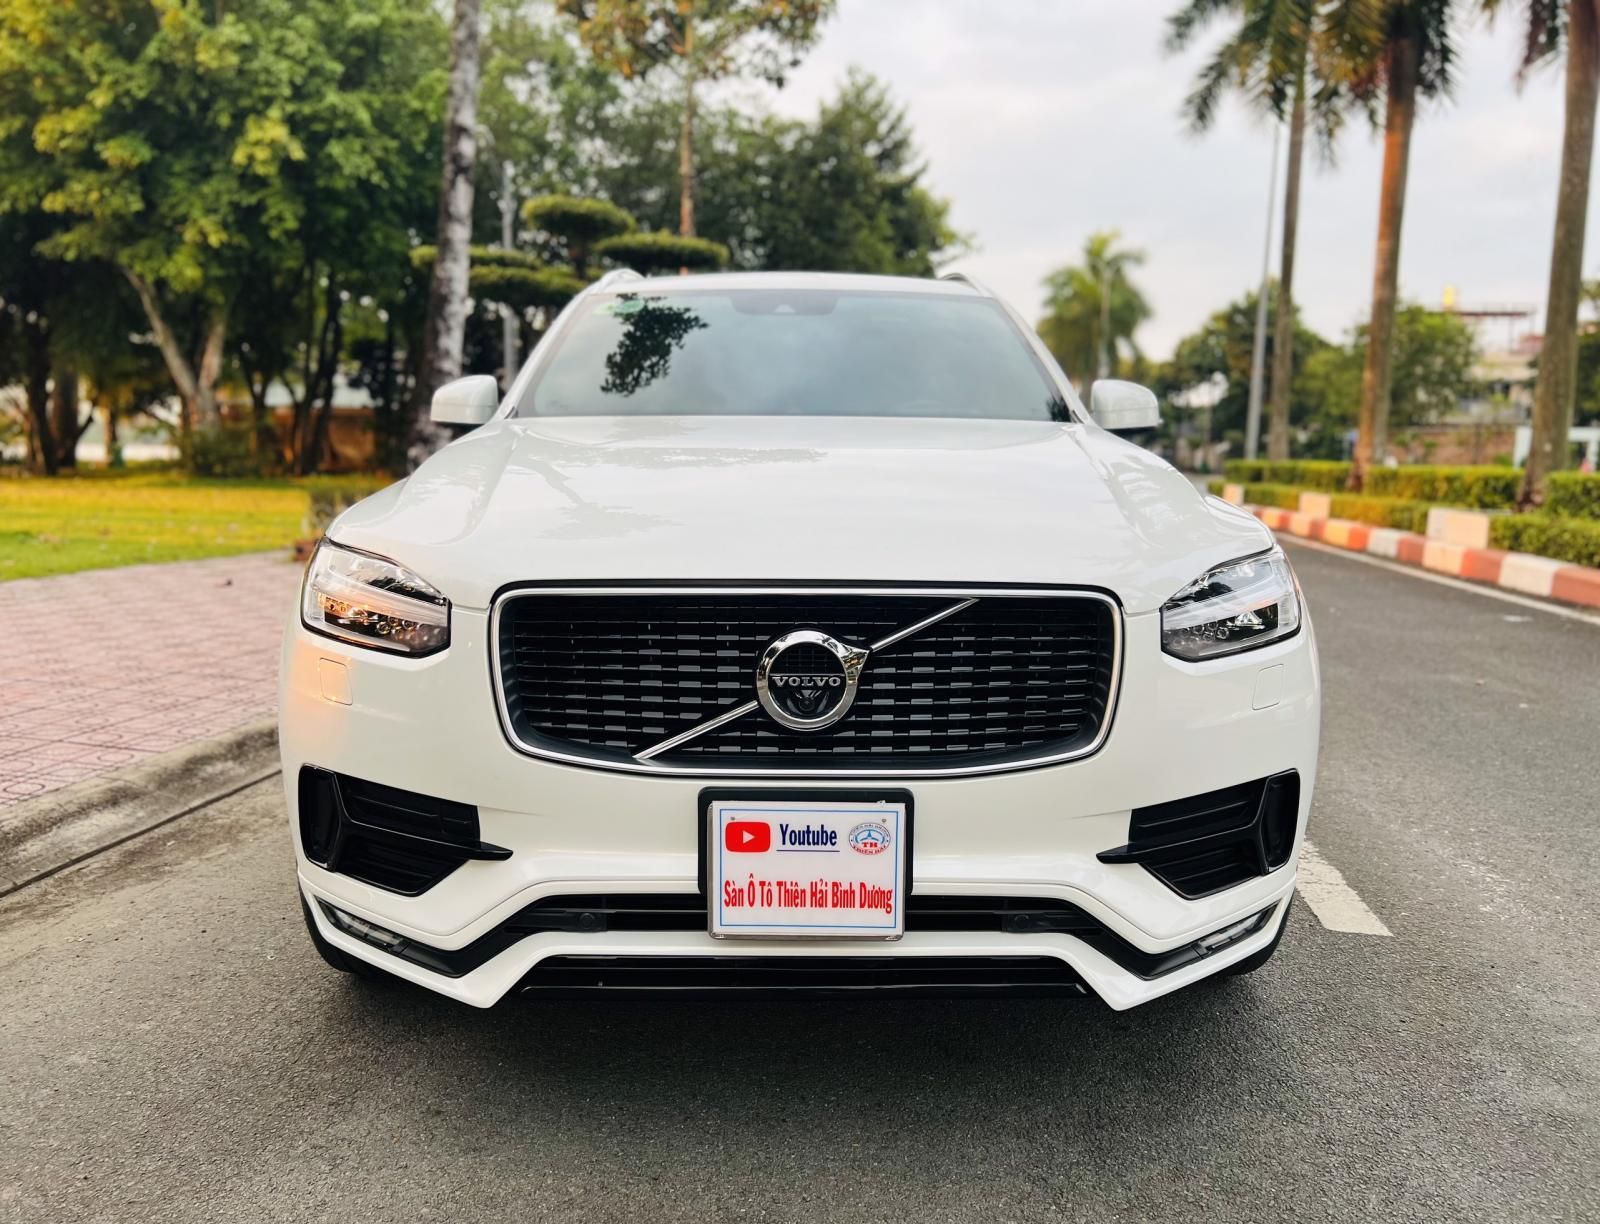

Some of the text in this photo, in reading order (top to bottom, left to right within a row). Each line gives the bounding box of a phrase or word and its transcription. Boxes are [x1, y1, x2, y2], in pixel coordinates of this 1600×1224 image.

[772, 677, 841, 687] VOLVO
[779, 823, 838, 847] Youtube
[724, 873, 893, 914] Sàn Ô Tô Thiên Hải Bình Dương
